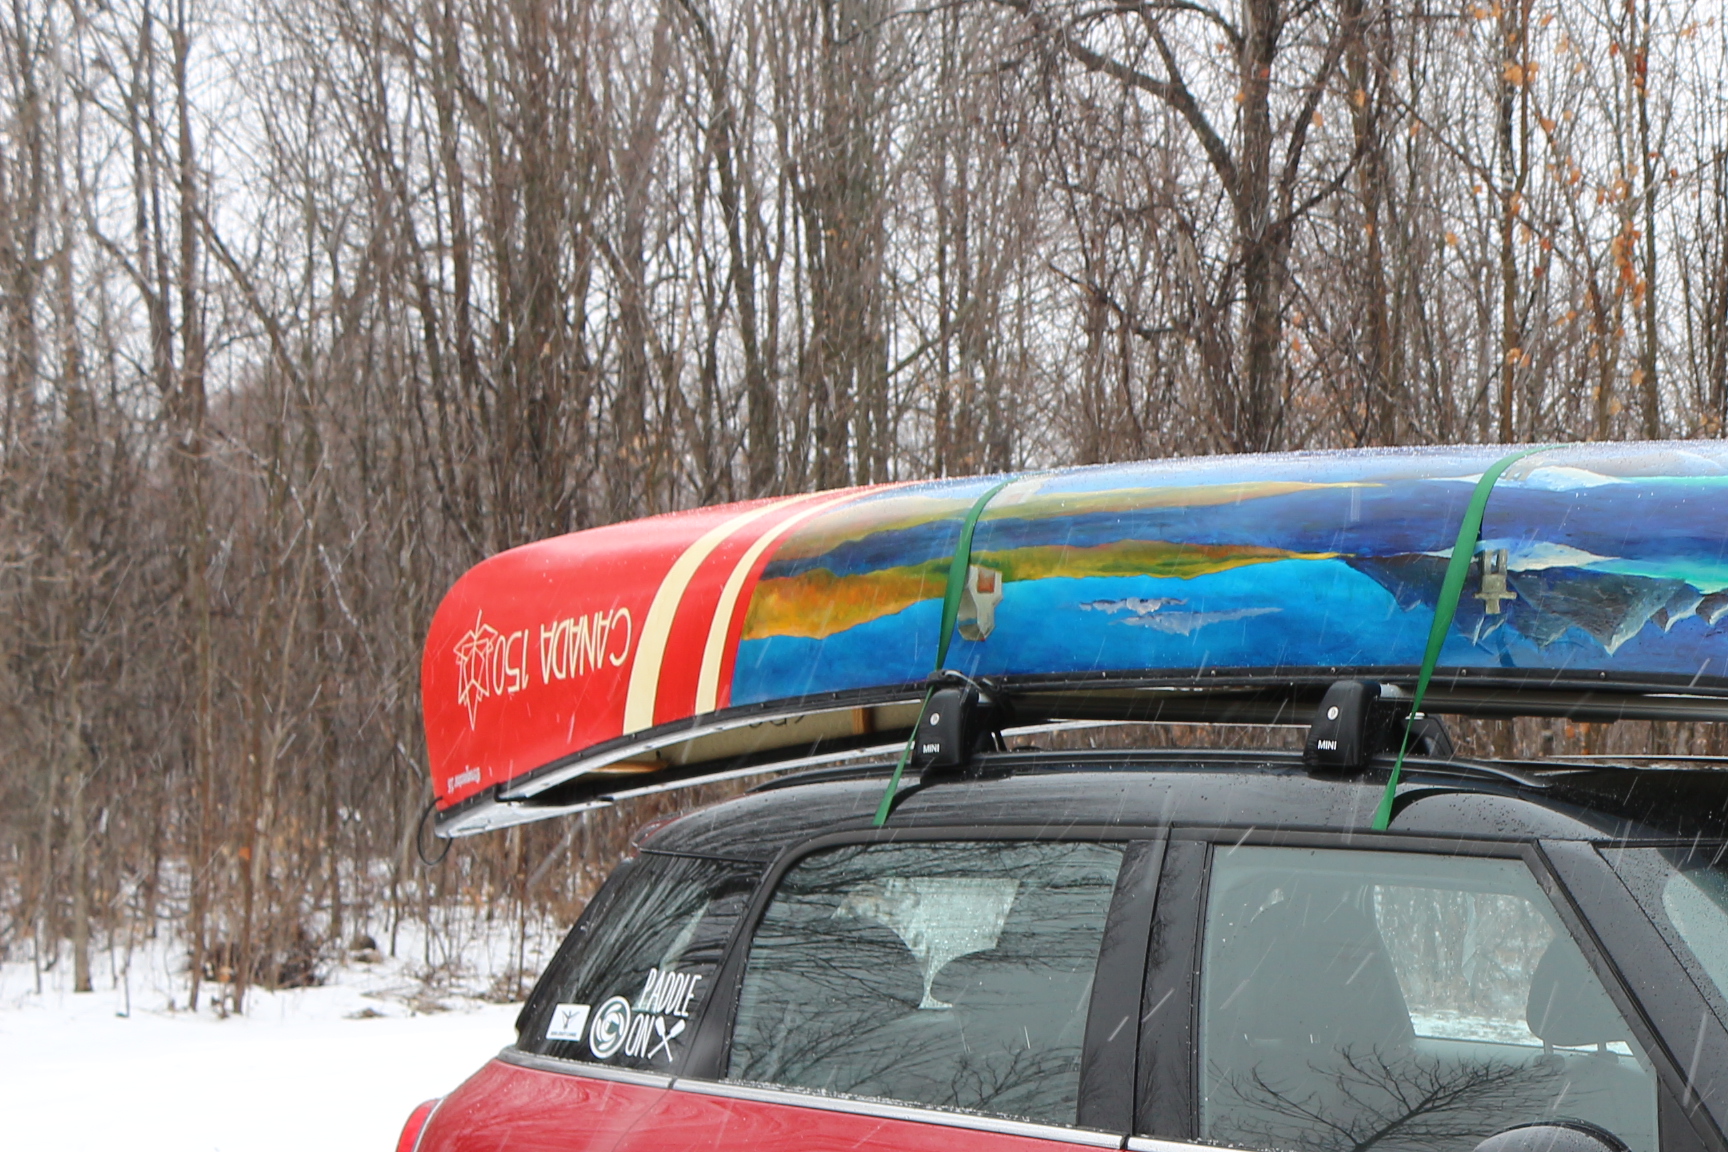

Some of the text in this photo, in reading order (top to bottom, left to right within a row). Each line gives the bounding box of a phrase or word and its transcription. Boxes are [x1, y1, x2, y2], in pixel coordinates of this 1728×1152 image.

[493, 607, 632, 695] CANADA 150
[922, 743, 940, 754] MINI
[1317, 739, 1337, 751] MINI
[638, 967, 702, 1018] PADDLE
[624, 1013, 656, 1058] ON
